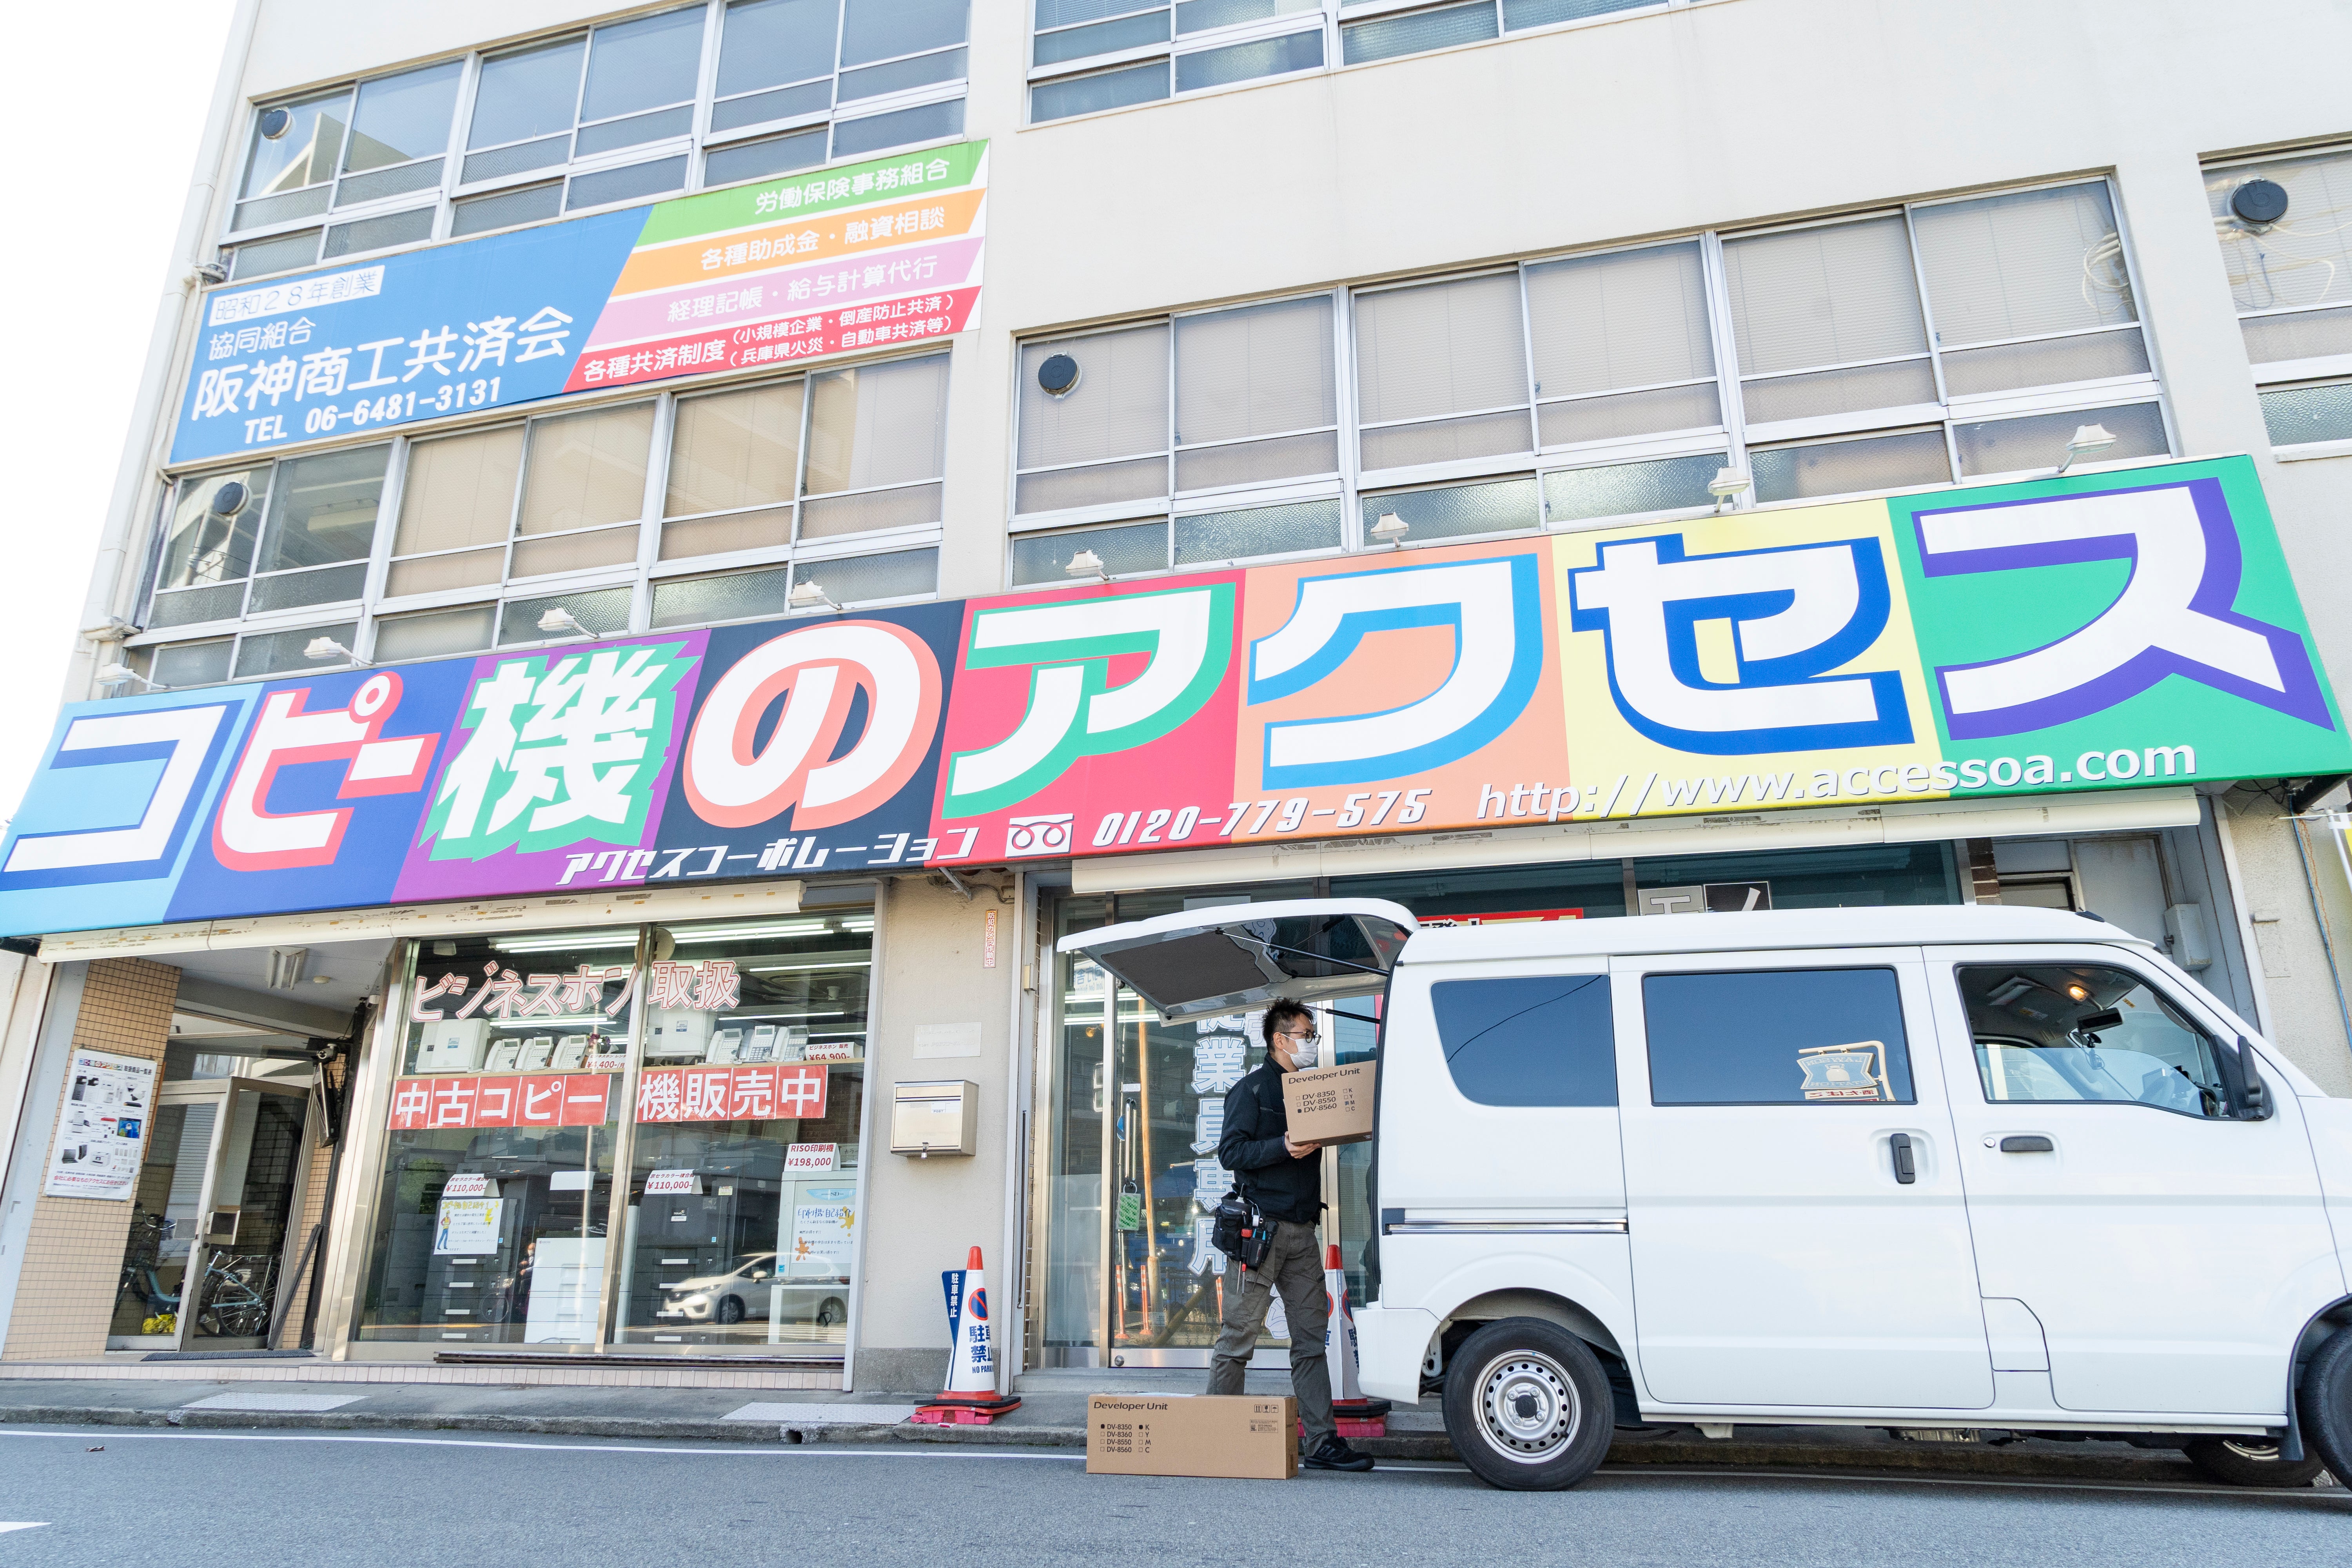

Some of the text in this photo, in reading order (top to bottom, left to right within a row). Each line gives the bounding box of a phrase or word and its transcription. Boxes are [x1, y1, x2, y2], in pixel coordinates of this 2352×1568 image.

[755, 158, 949, 215] 労働保険事務組合
[701, 206, 945, 270] 各種助成金・融資相談
[216, 270, 377, 321] 昭和28年創業
[667, 255, 938, 323] 経理記帳・給与計算代行
[209, 316, 316, 361] 協同組合
[584, 338, 727, 382] 各種共済制度
[191, 306, 573, 421] 阪神商工共済会
[245, 377, 501, 444] TEL 06-6481-3131
[0, 477, 2336, 891] コピー機のアクセス
[1476, 744, 2197, 822] http://www.accessoa.com
[1092, 788, 1432, 848] 0120-779-575
[555, 826, 980, 886] アクセスコーポレーション
[986, 912, 995, 966] 防犯カメラ作動中
[1289, 1068, 1361, 1084] Developer Unit
[1302, 1090, 1335, 1100] DV-8350
[1303, 1097, 1336, 1106] DV-8550
[1304, 1103, 1337, 1113] DV-8560
[788, 1158, 831, 1168] ¥198,000
[791, 1144, 834, 1152] RISO印刷機
[446, 1184, 486, 1193] ¥110,000-
[647, 1181, 692, 1191] ¥110,000-
[950, 1273, 959, 1318] 駐車禁止
[1094, 1401, 1168, 1411] Developer Unit
